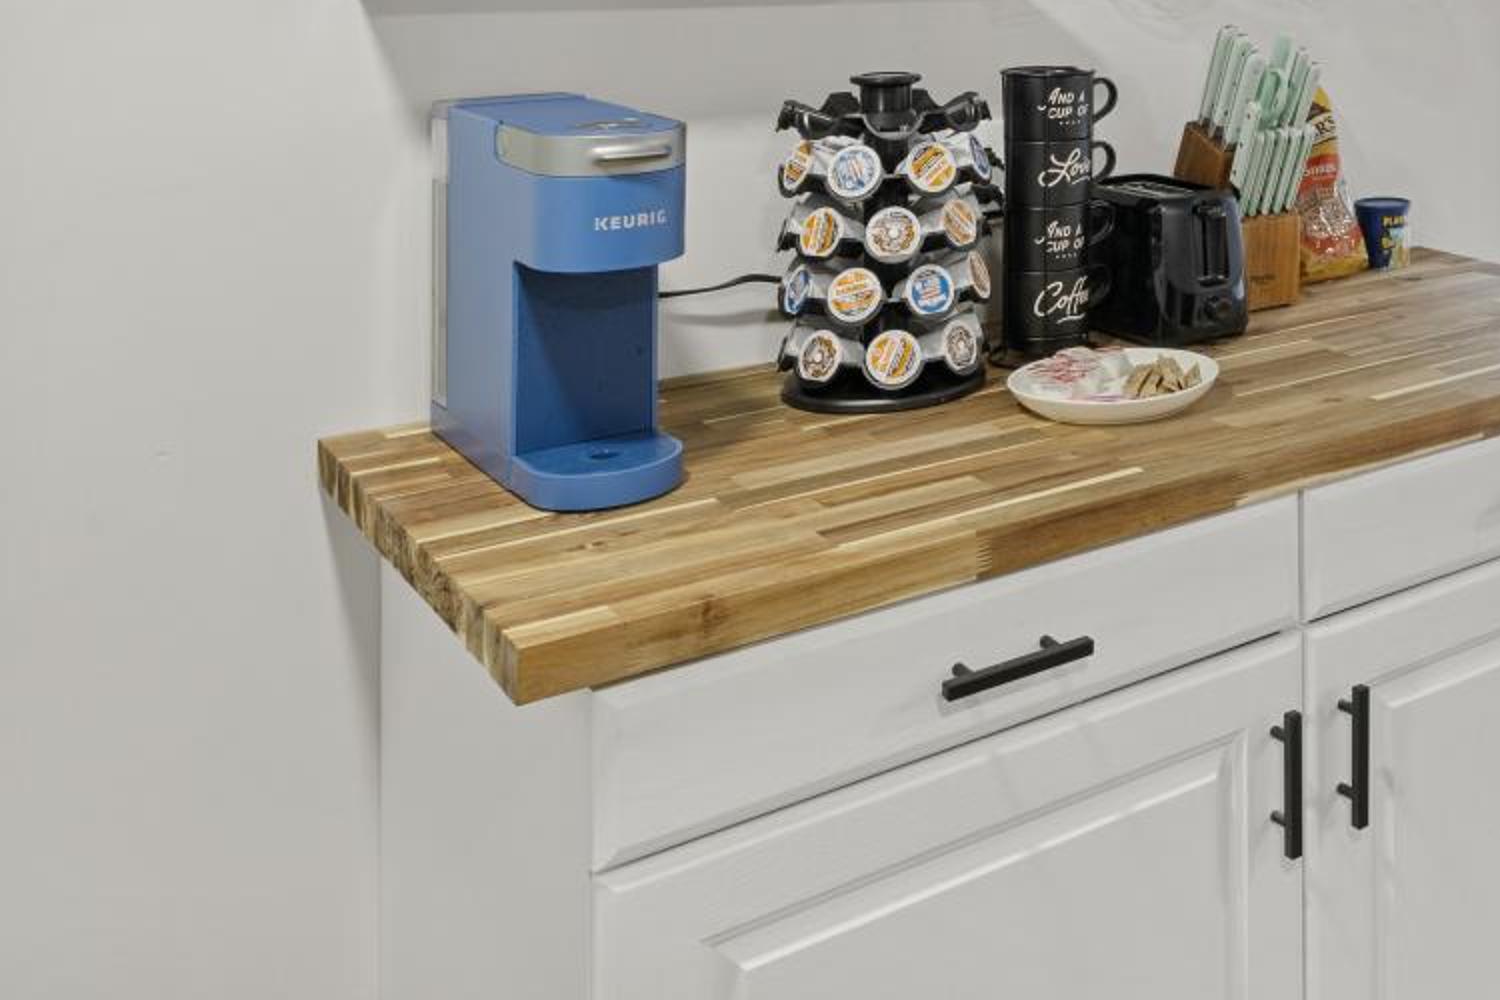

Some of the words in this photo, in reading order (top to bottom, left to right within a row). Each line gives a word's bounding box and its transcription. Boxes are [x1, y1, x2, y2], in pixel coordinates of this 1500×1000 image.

[1048, 87, 1074, 104] AND
[1048, 106, 1073, 119] CUP
[594, 209, 667, 231] KEURIG
